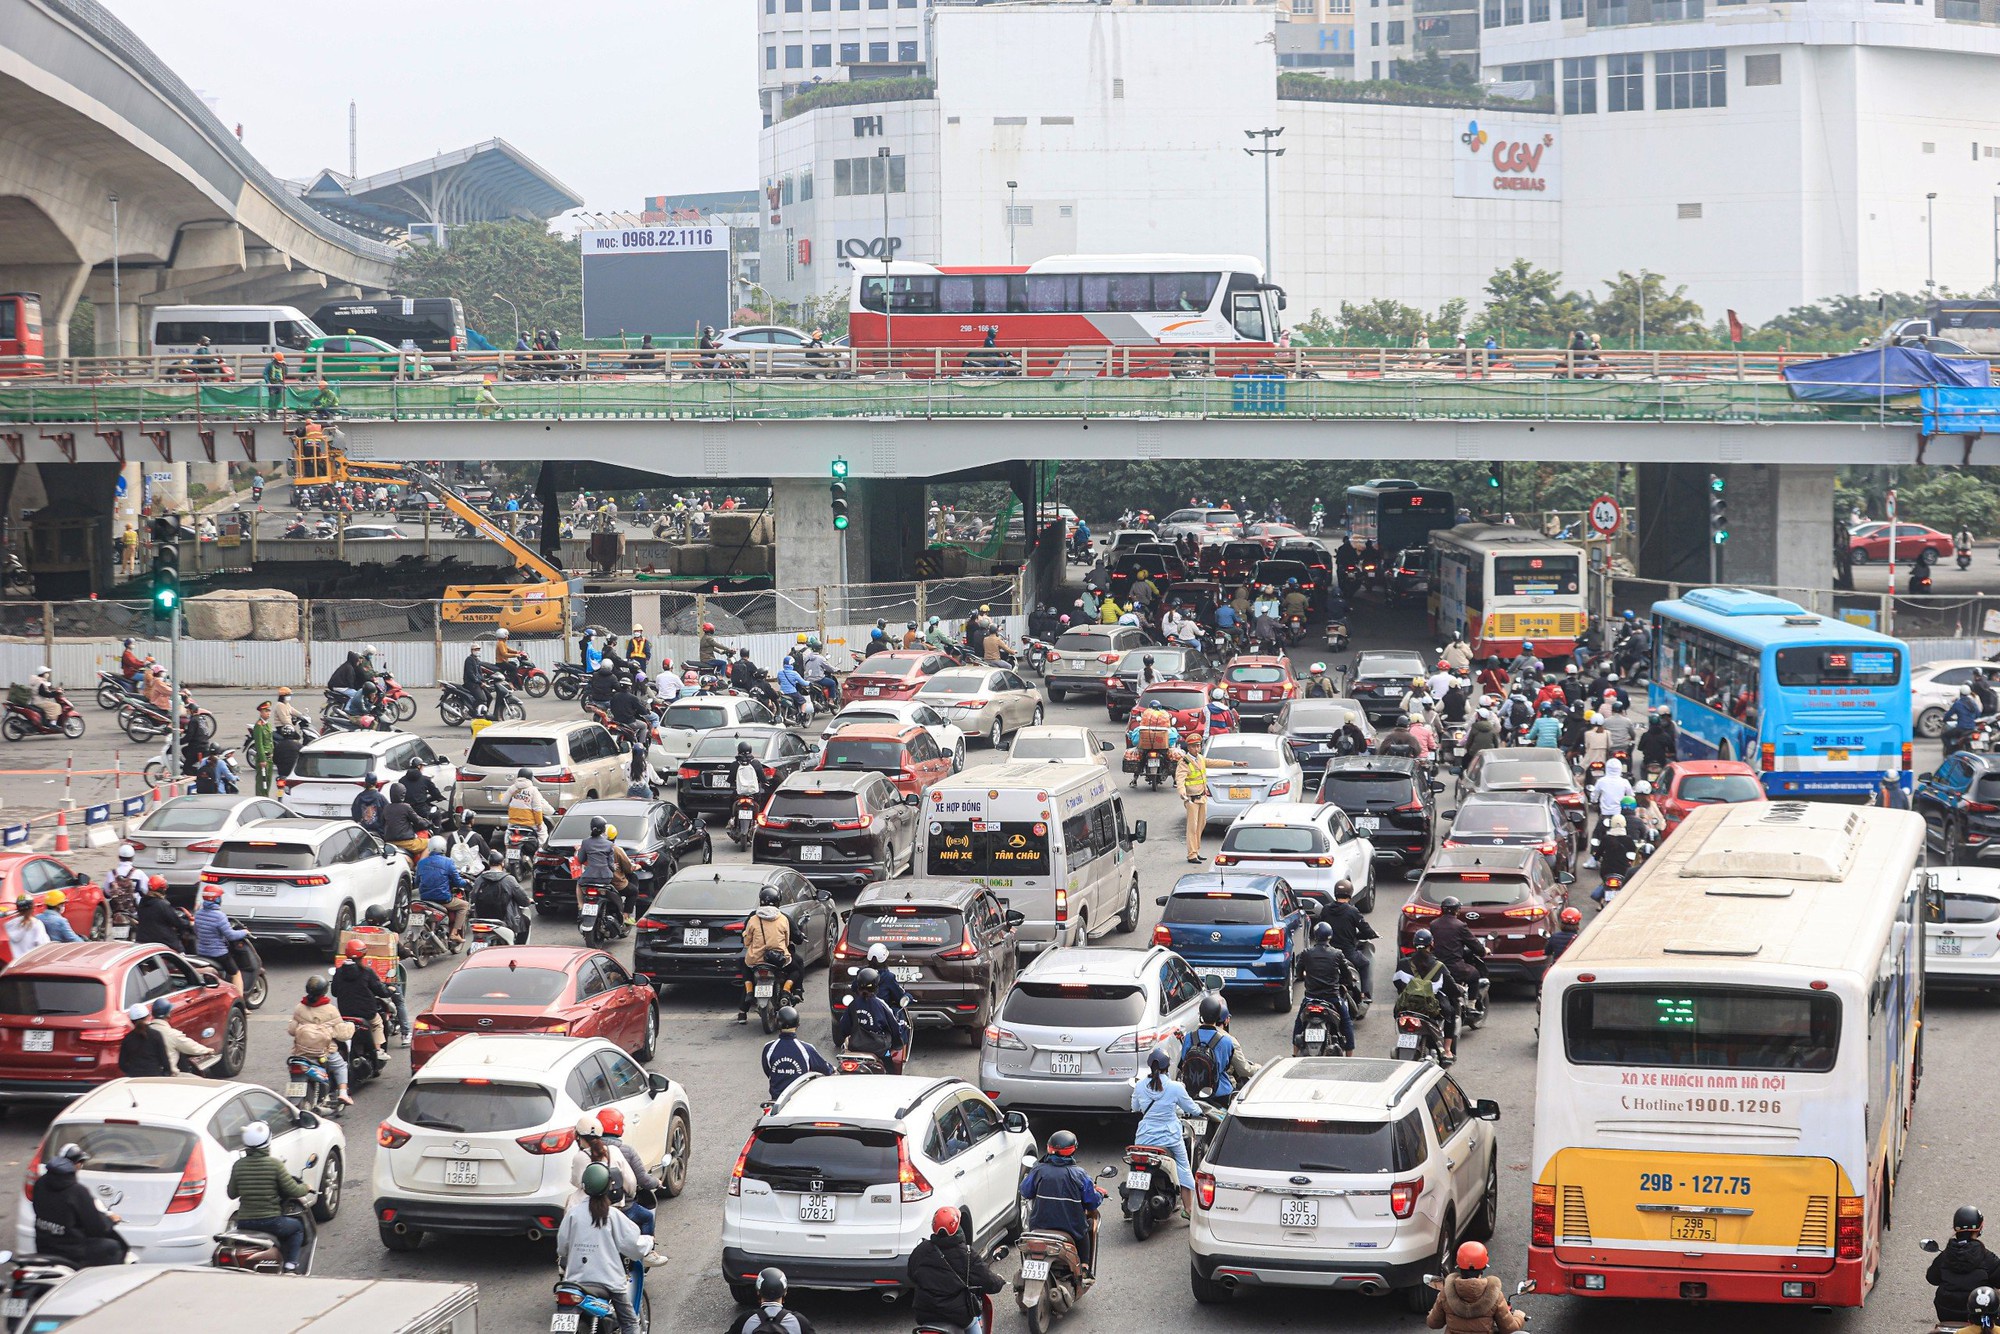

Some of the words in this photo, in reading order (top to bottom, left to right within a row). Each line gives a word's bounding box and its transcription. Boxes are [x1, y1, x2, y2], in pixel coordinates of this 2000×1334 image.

[1492, 141, 1544, 173] CGV
[1493, 176, 1546, 192] CINEMAS
[597, 238, 618, 249] MQC:
[622, 229, 713, 248] 0968.22.1116
[837, 237, 902, 259] LOOP
[154, 472, 172, 481] P244
[935, 803, 945, 813] XE
[946, 802, 960, 814] HỢP
[939, 849, 959, 860] NHÀ
[960, 851, 973, 860] XE
[995, 849, 1014, 860] TÂM
[1015, 849, 1041, 860] CHÂU
[989, 878, 1013, 887] 006.31
[1058, 1053, 1074, 1064] 30A
[1641, 1073, 1657, 1086] XE
[1661, 1072, 1704, 1089] KHÁCH
[1707, 1076, 1738, 1090] NAM
[1741, 1074, 1758, 1090] HÀ
[1762, 1075, 1786, 1092] NỘI
[1634, 1097, 1684, 1112] Hotline
[1686, 1098, 1782, 1114] 1900.1296
[454, 1161, 471, 1173] 19A
[1639, 1173, 1673, 1193] 29B
[1691, 1176, 1751, 1195] 127.75
[808, 1195, 828, 1207] 30E
[1289, 1200, 1310, 1213] 30E
[800, 1207, 834, 1220] 078.21
[1282, 1213, 1317, 1226] 937.33
[1684, 1218, 1704, 1228] 29B
[1676, 1228, 1712, 1239] 127.75
